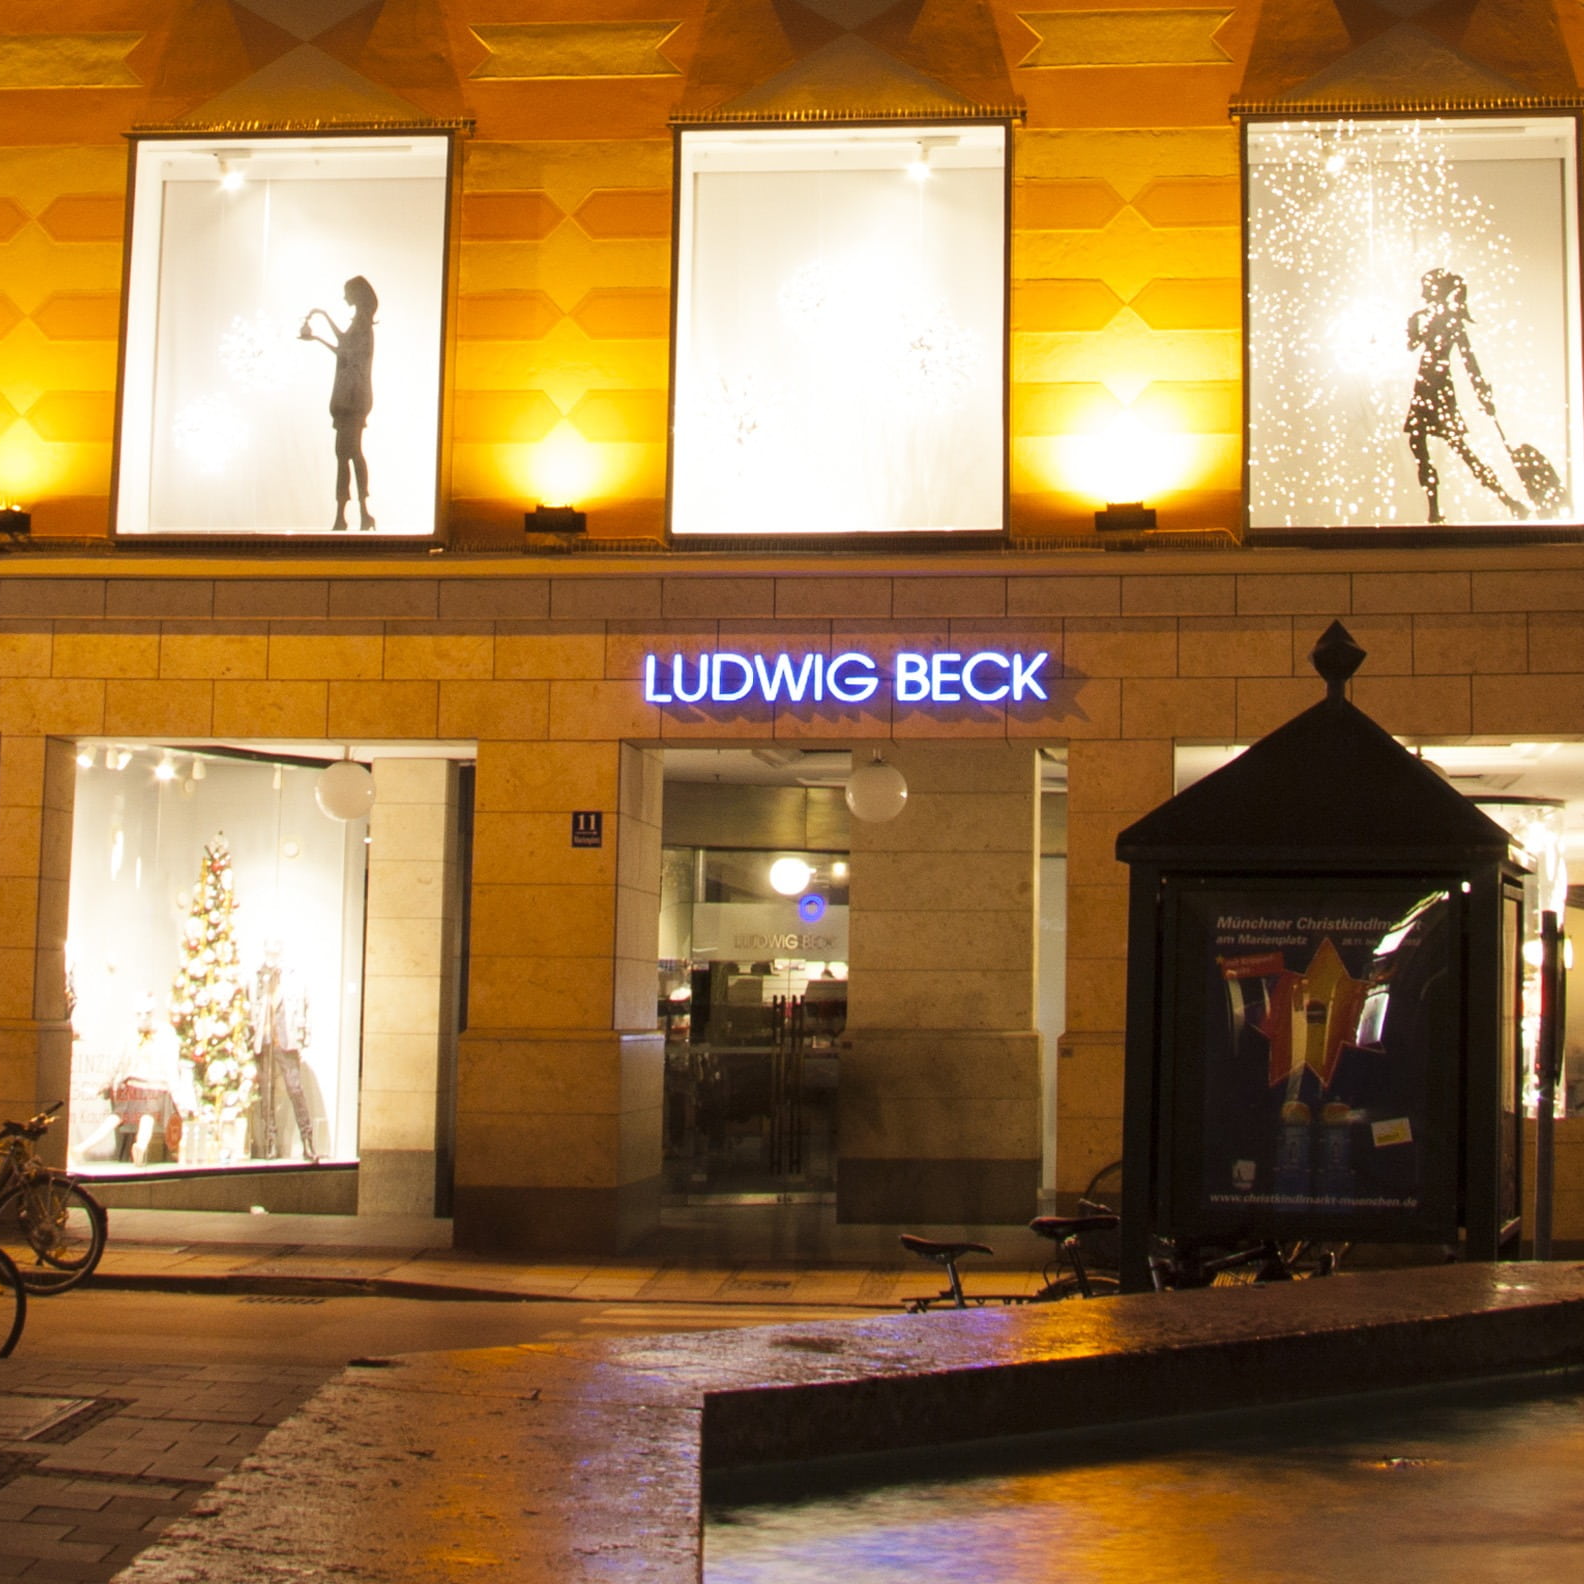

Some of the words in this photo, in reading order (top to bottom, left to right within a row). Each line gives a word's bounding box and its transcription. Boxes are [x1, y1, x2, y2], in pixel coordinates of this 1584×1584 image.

[643, 652, 879, 704] LUDWIG
[895, 651, 1050, 702] BECK
[577, 814, 596, 830] 11
[1217, 916, 1292, 929] Münchner
[734, 934, 798, 949] LUDWIG
